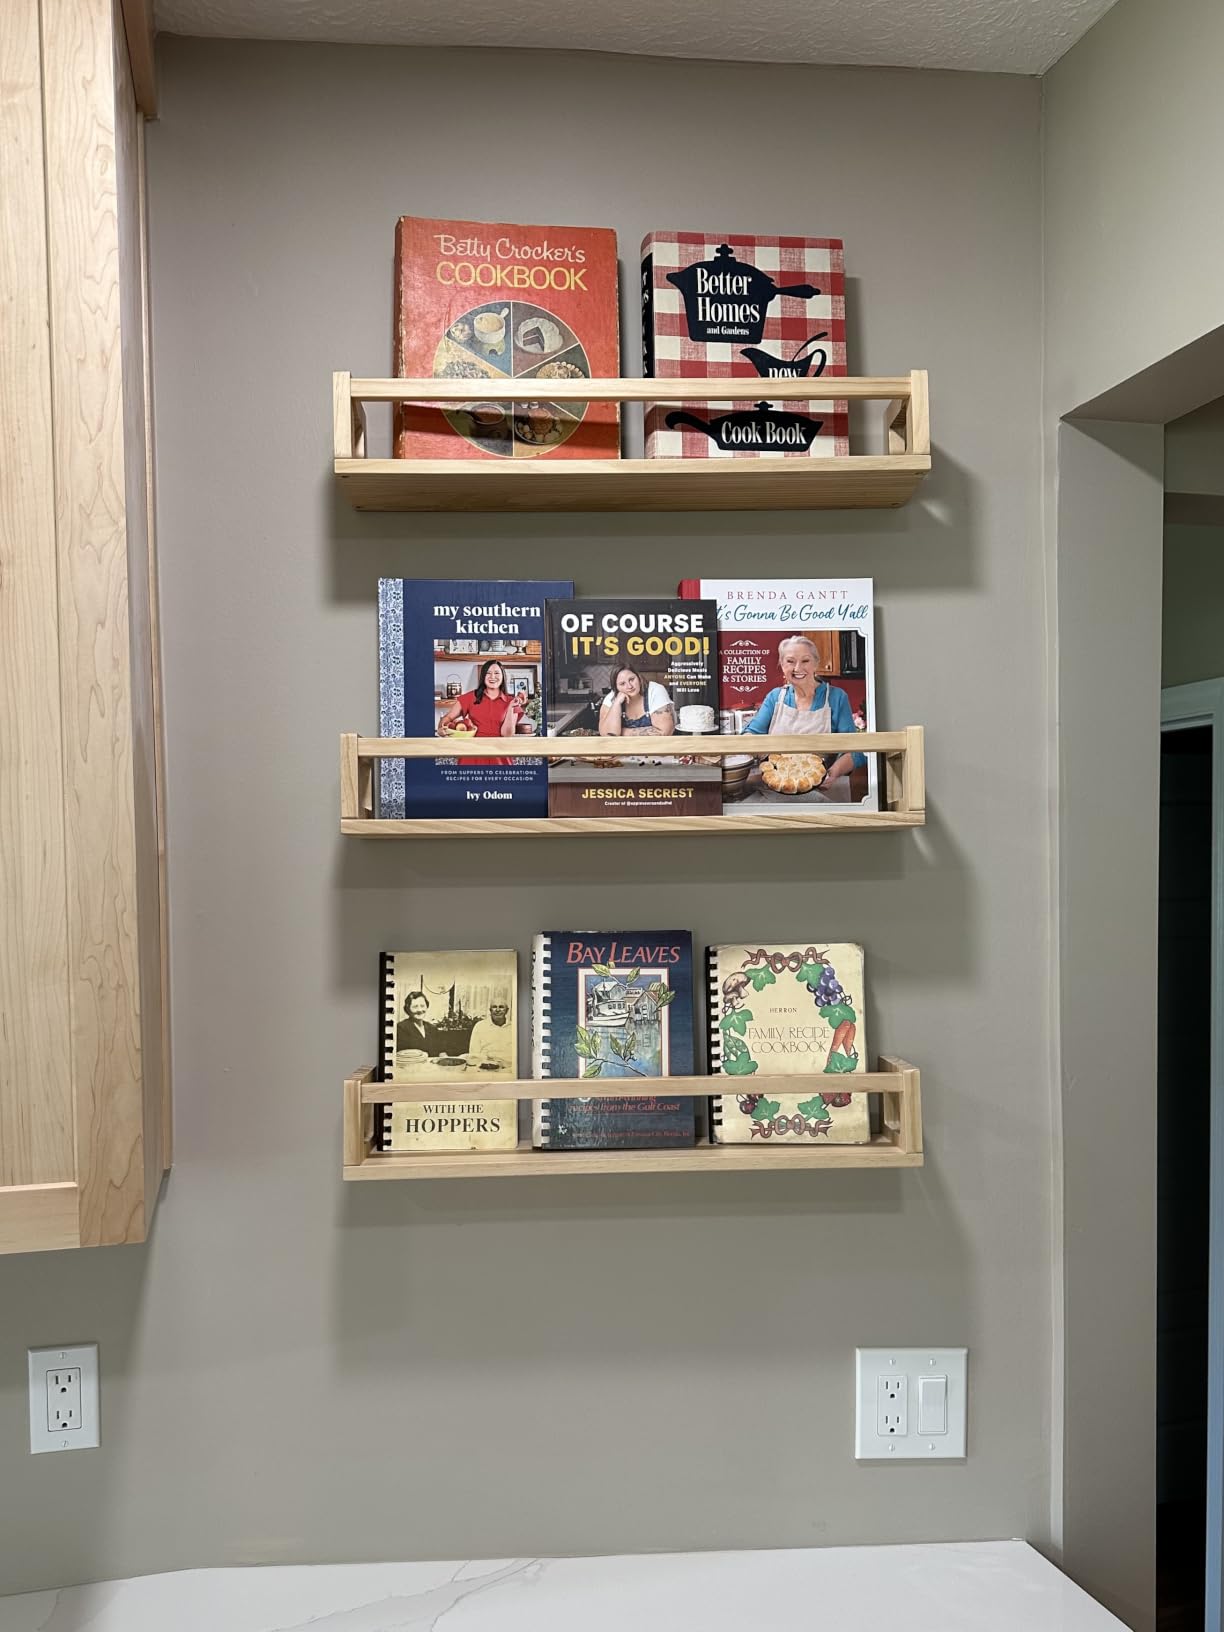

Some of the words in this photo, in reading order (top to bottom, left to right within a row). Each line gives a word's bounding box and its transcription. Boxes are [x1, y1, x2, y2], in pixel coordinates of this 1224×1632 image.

[433, 234, 491, 262] Betty
[495, 238, 586, 264] Crocker's
[436, 261, 588, 291] COOKBOOK
[696, 267, 752, 296] Better
[697, 296, 760, 323] Homes
[706, 326, 720, 335] and
[721, 326, 750, 336] Gardens
[721, 421, 763, 445] Cook
[765, 421, 807, 445] Book
[727, 590, 788, 600] BRENDA
[796, 590, 849, 600] GANTT
[433, 605, 458, 619] my
[463, 603, 541, 618] southern
[733, 604, 777, 622] Gonna
[778, 604, 798, 622] Be
[799, 603, 835, 621] Good
[836, 603, 869, 621] Y'all
[455, 619, 519, 634] kitchen
[561, 613, 594, 633] OF
[601, 613, 704, 633] COURSE
[571, 636, 619, 656] IT'S
[626, 636, 710, 656] GOOD!
[726, 656, 762, 665] FAMILY
[722, 664, 767, 674] RECIPES
[722, 674, 729, 683] &
[730, 674, 767, 683] STORIES
[466, 790, 480, 801] Ivy
[483, 790, 513, 800] Odom
[581, 788, 635, 799] JESSICA
[638, 787, 694, 799] SECREST
[567, 942, 605, 963] BAY
[609, 942, 681, 964] LEAVES
[748, 1026, 785, 1041] FAMILY
[788, 1026, 830, 1040] RECIPE
[752, 1041, 827, 1053] COOKBOOK
[423, 1104, 456, 1114] WITH
[459, 1104, 484, 1114] THE
[622, 1101, 636, 1112] the
[637, 1102, 656, 1112] Gulf
[656, 1102, 680, 1112] Coast
[405, 1117, 501, 1133] HOPPERS
